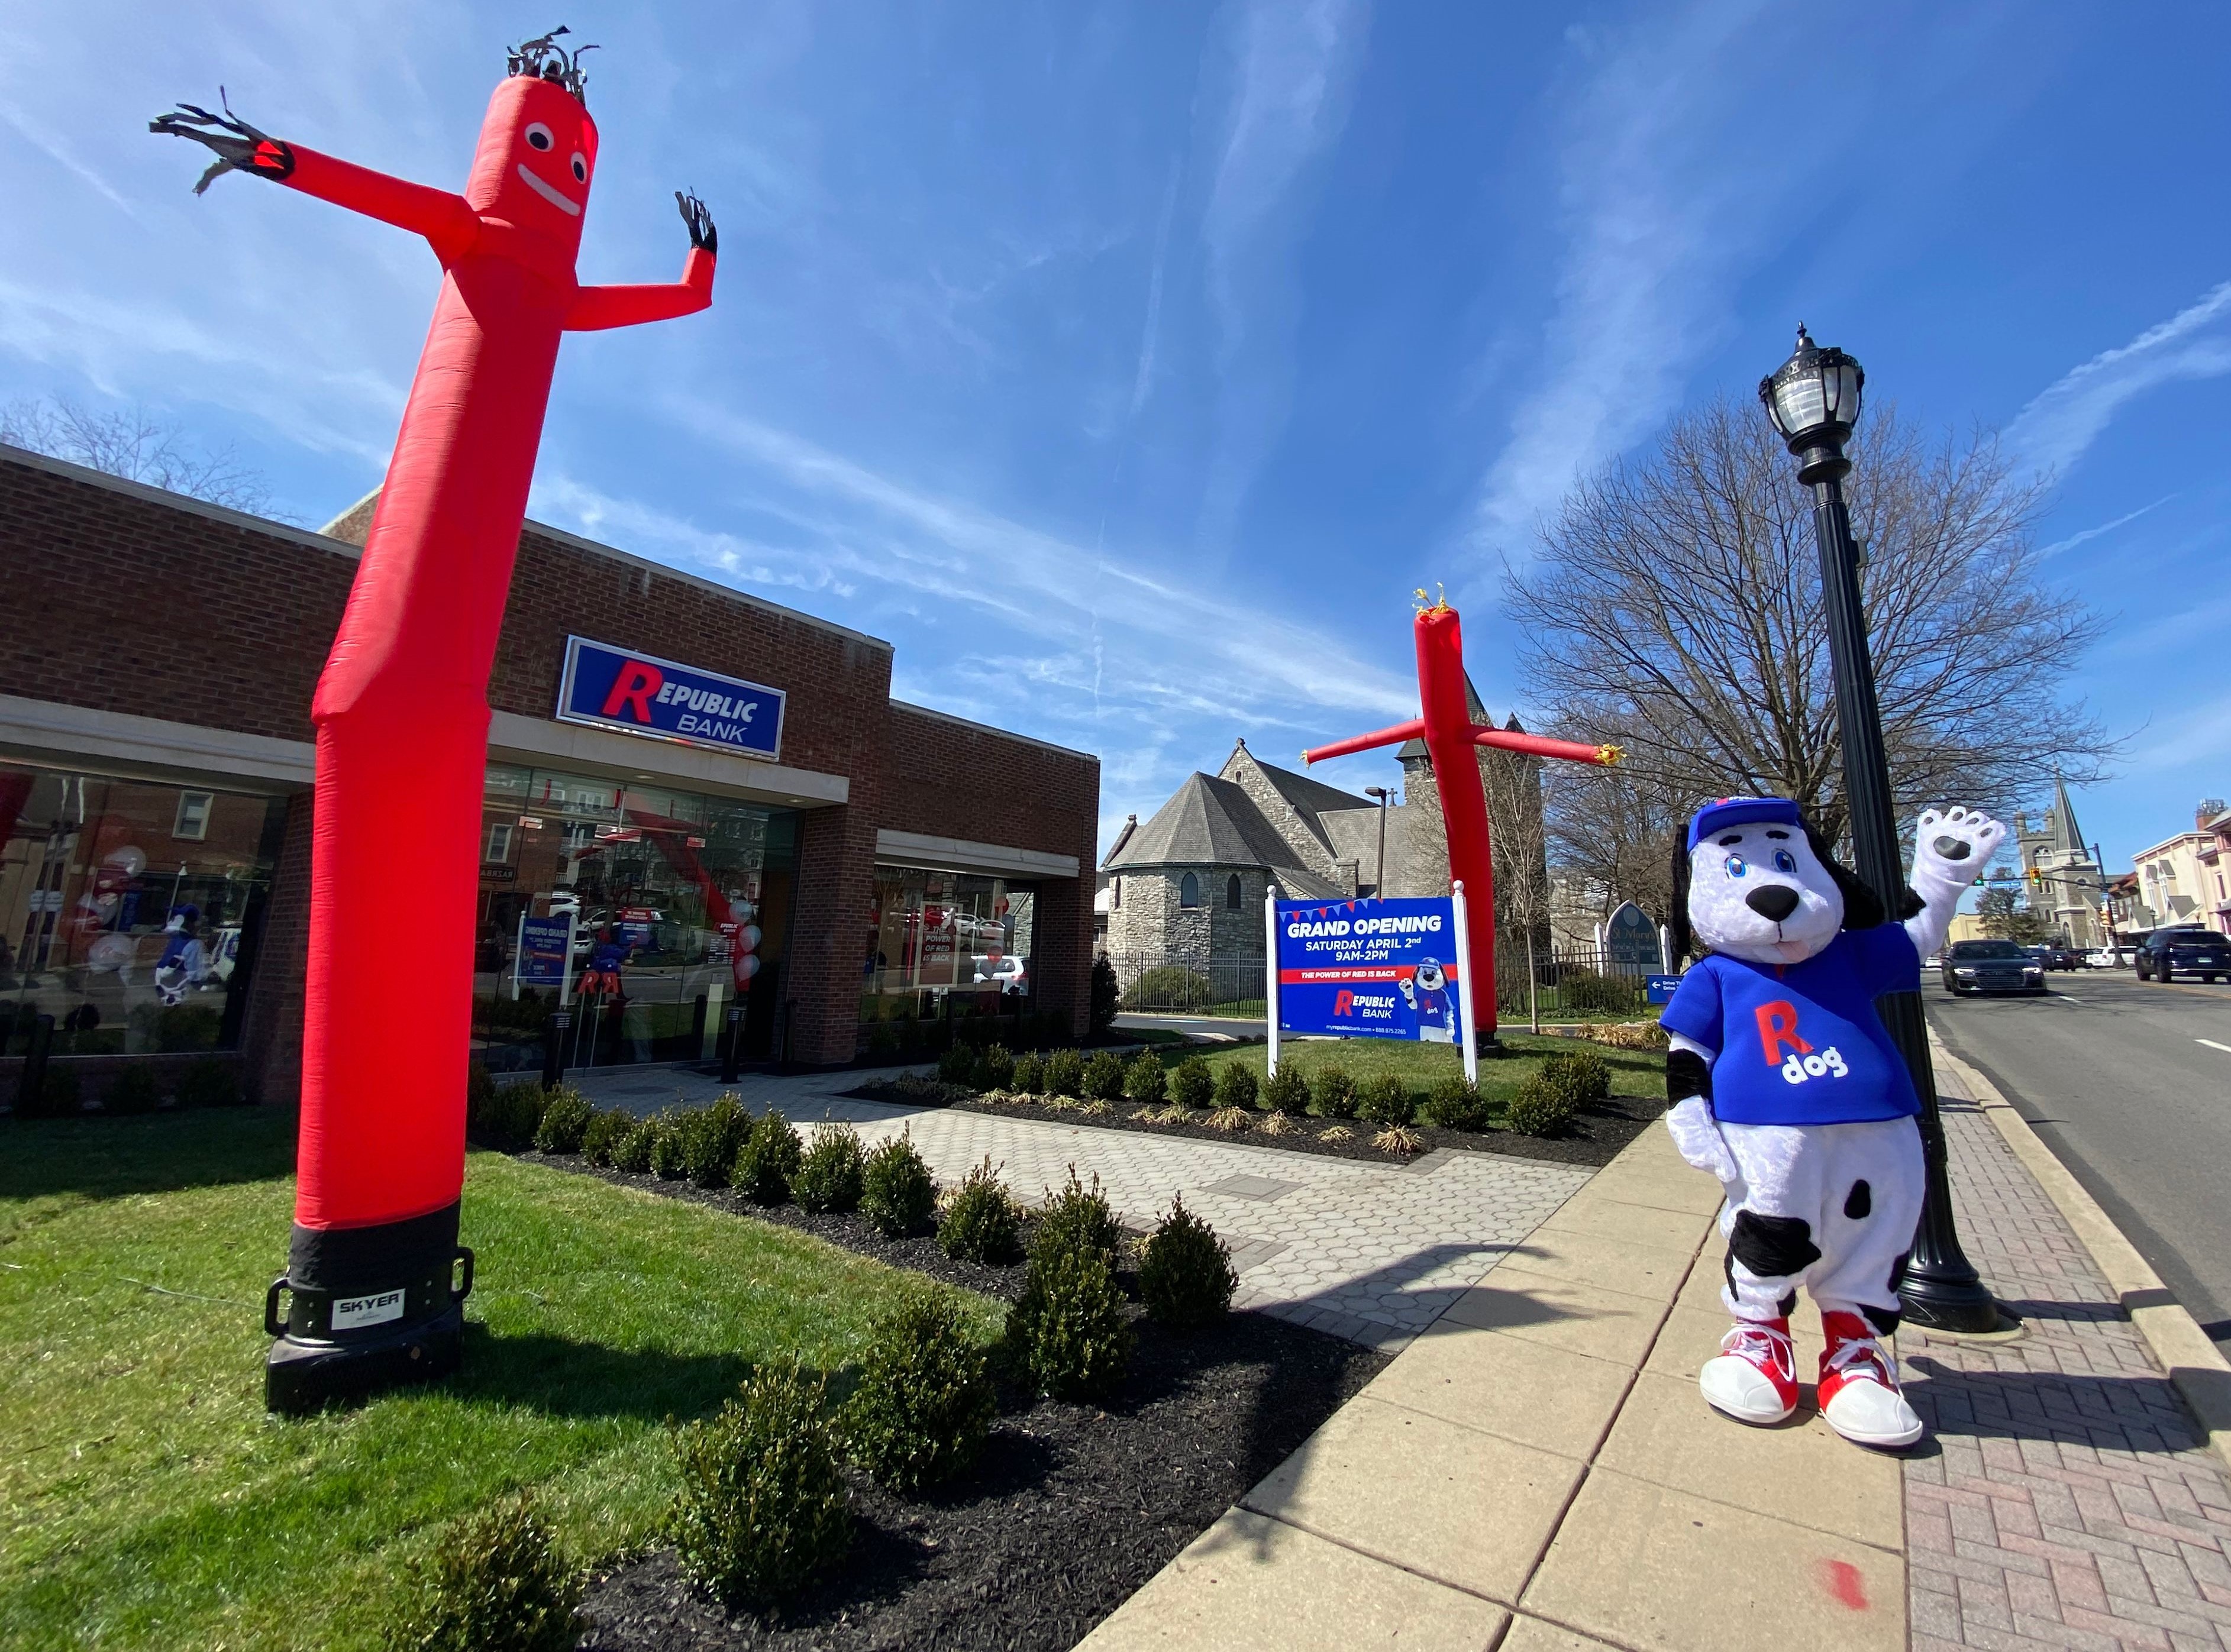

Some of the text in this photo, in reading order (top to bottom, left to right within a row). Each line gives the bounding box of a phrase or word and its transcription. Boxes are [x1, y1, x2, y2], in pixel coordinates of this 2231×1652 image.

[602, 659, 758, 723] REPUBLIC
[676, 714, 748, 743] BANK
[933, 926, 947, 934] THE
[1287, 915, 1442, 938] GRAND OPENING
[1623, 927, 1655, 942] Mary's
[1306, 937, 1422, 951] SATURDAY APRIL 2nd
[1335, 950, 1389, 961] 9AM-2PM
[1334, 990, 1396, 1017] REPUBLIC
[1362, 1008, 1393, 1019] BANK
[1755, 1001, 1814, 1067] R
[1781, 1046, 1849, 1085] dog
[340, 1293, 399, 1313] SKYER
